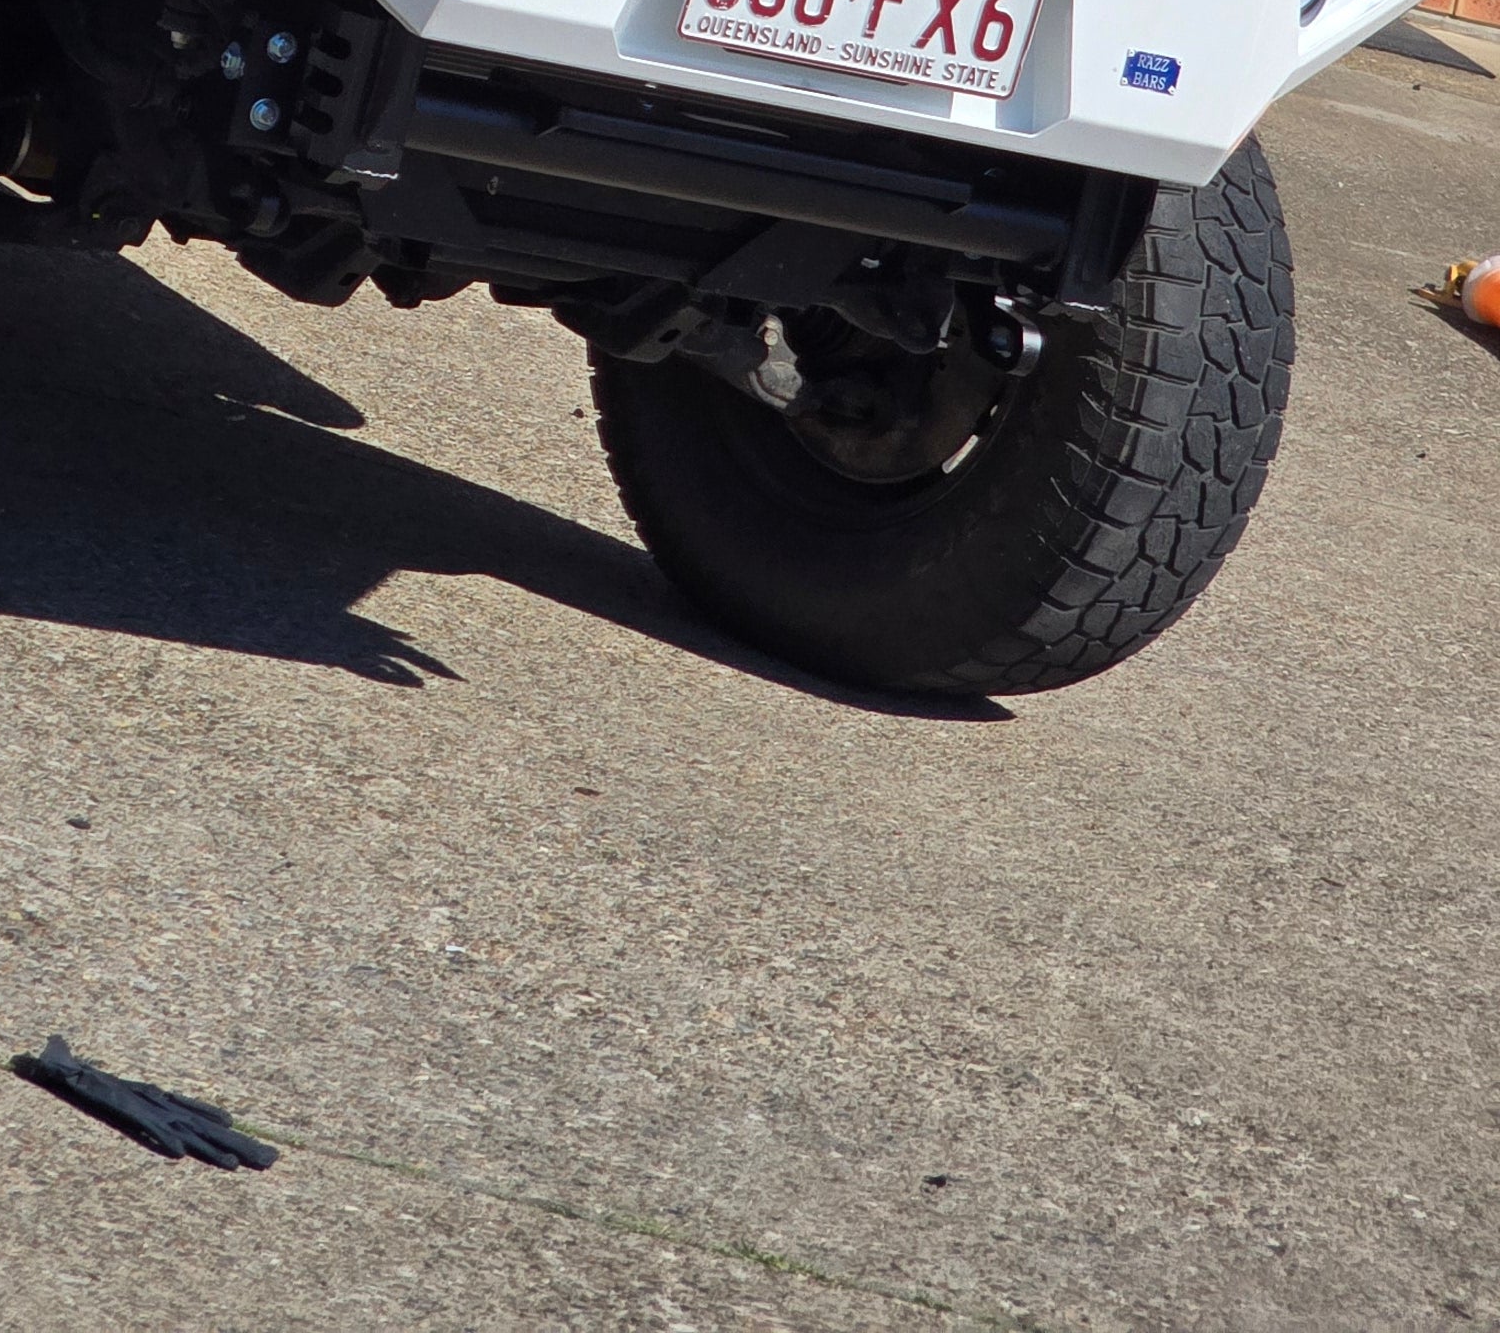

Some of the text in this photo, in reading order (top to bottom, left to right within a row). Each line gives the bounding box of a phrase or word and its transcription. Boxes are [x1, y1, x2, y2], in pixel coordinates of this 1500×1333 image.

[696, 15, 822, 55] QUEENSLAND
[840, 42, 936, 77] SUNSHINE
[941, 63, 1000, 90] STATE
[1137, 53, 1171, 73] RAZZ
[1132, 71, 1167, 91] BARS
